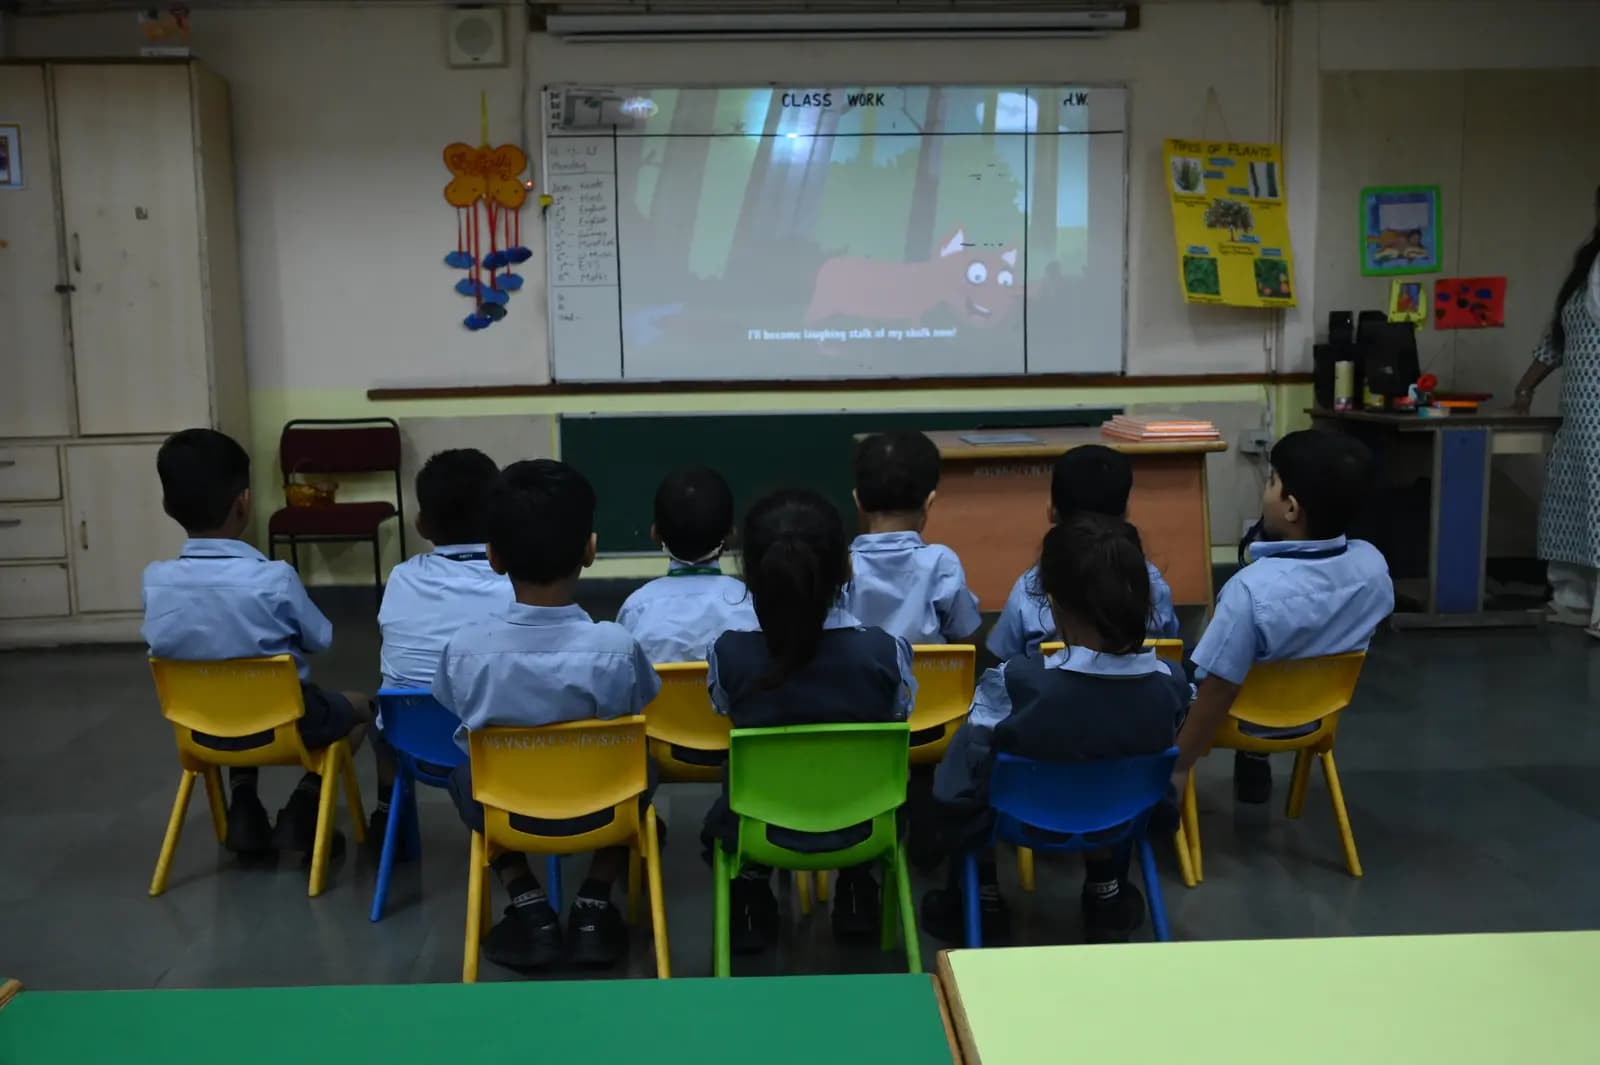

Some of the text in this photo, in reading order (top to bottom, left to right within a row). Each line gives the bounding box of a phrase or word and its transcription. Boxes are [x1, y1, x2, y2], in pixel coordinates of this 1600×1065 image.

[782, 93, 885, 107] CLASS WORK
[1207, 143, 1222, 155] OF
[1228, 143, 1273, 157] PLANTS
[763, 328, 801, 340] become
[803, 327, 847, 342] laughing
[887, 329, 902, 341] my
